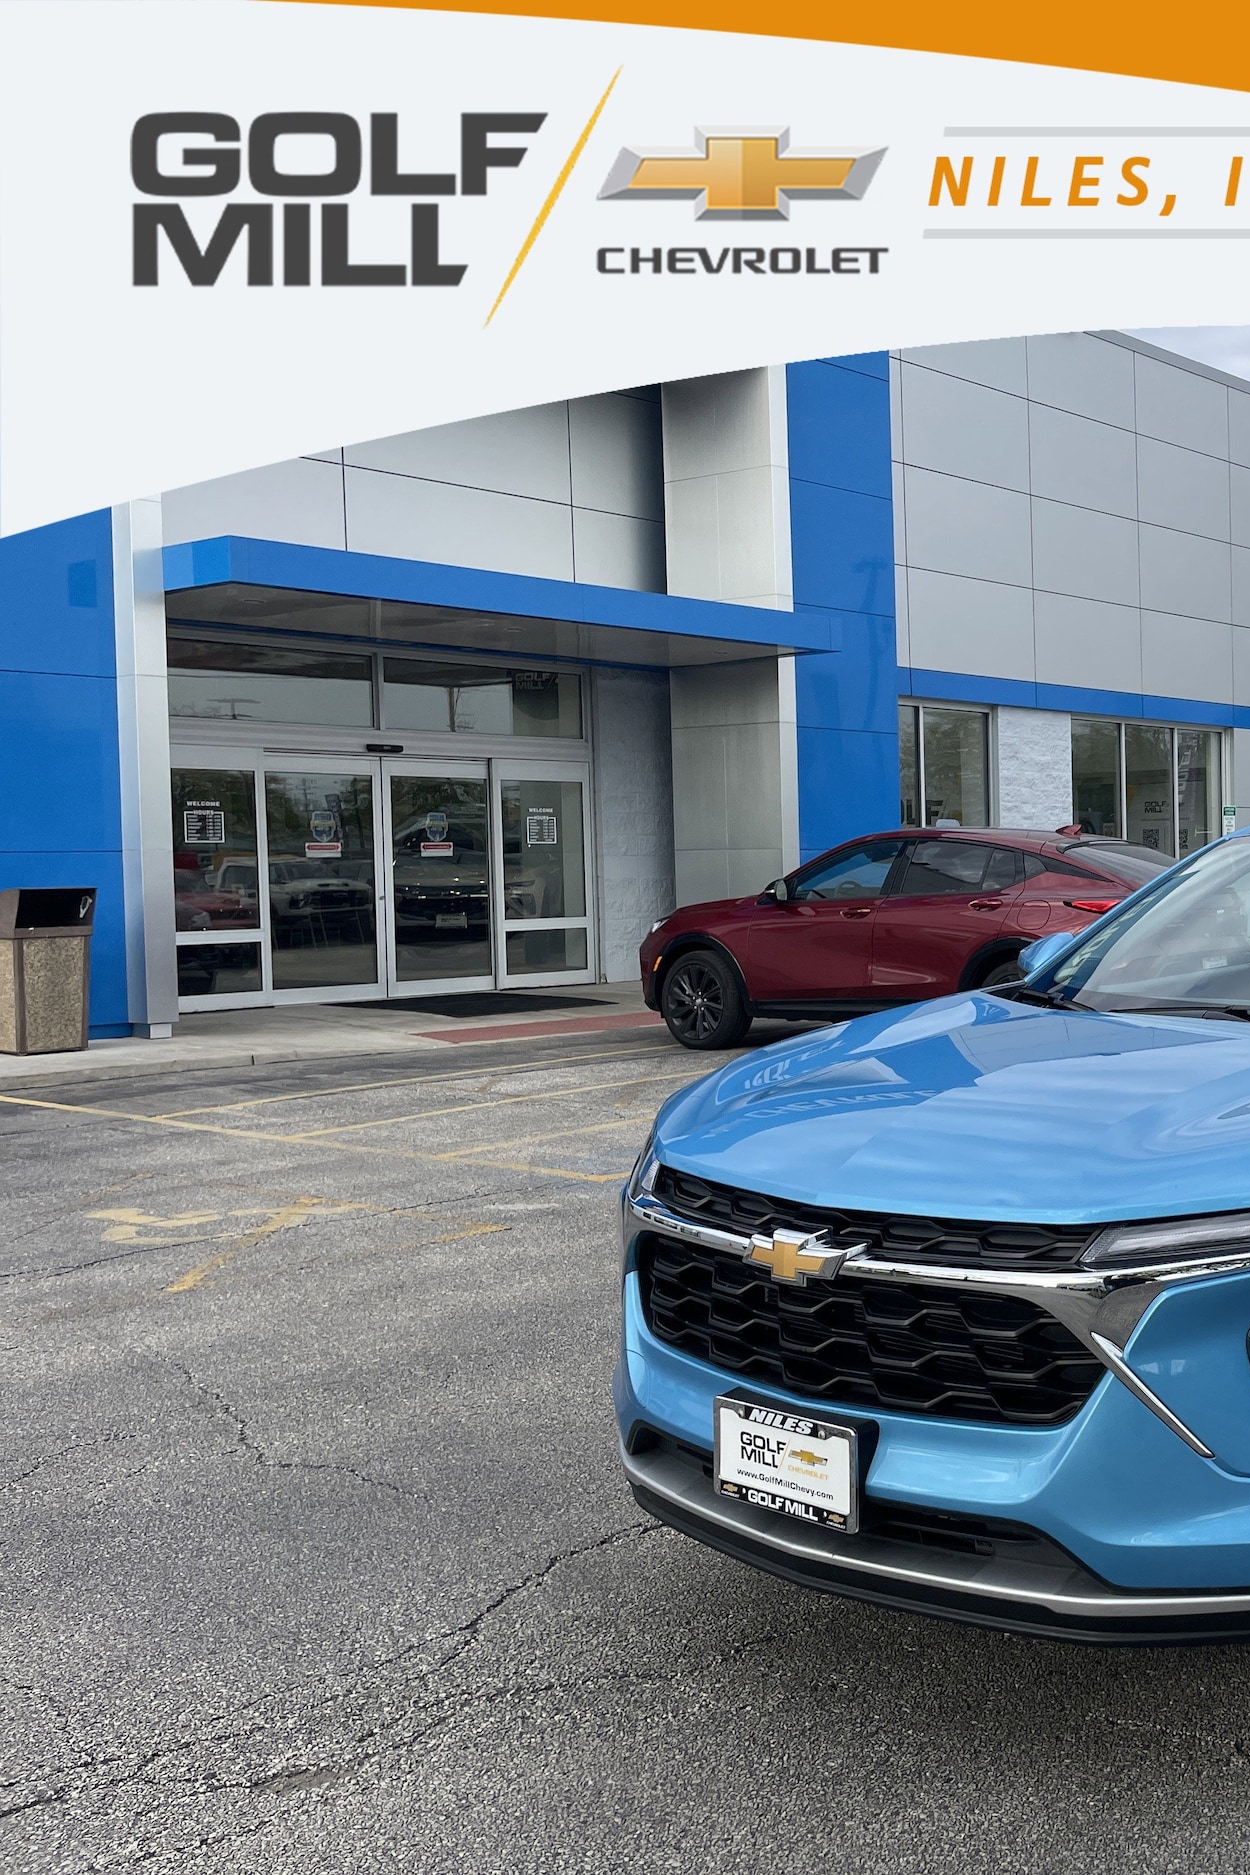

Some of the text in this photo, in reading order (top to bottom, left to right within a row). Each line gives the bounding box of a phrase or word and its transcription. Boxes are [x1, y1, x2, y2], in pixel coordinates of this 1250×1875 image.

[1144, 800, 1167, 808] GOLF
[748, 1408, 814, 1435] NILES
[740, 1431, 787, 1455] GOLF
[740, 1445, 779, 1469] MILL
[737, 1468, 834, 1501] www.GolfMillChevy.com
[747, 1489, 819, 1521] GOLF MILL
